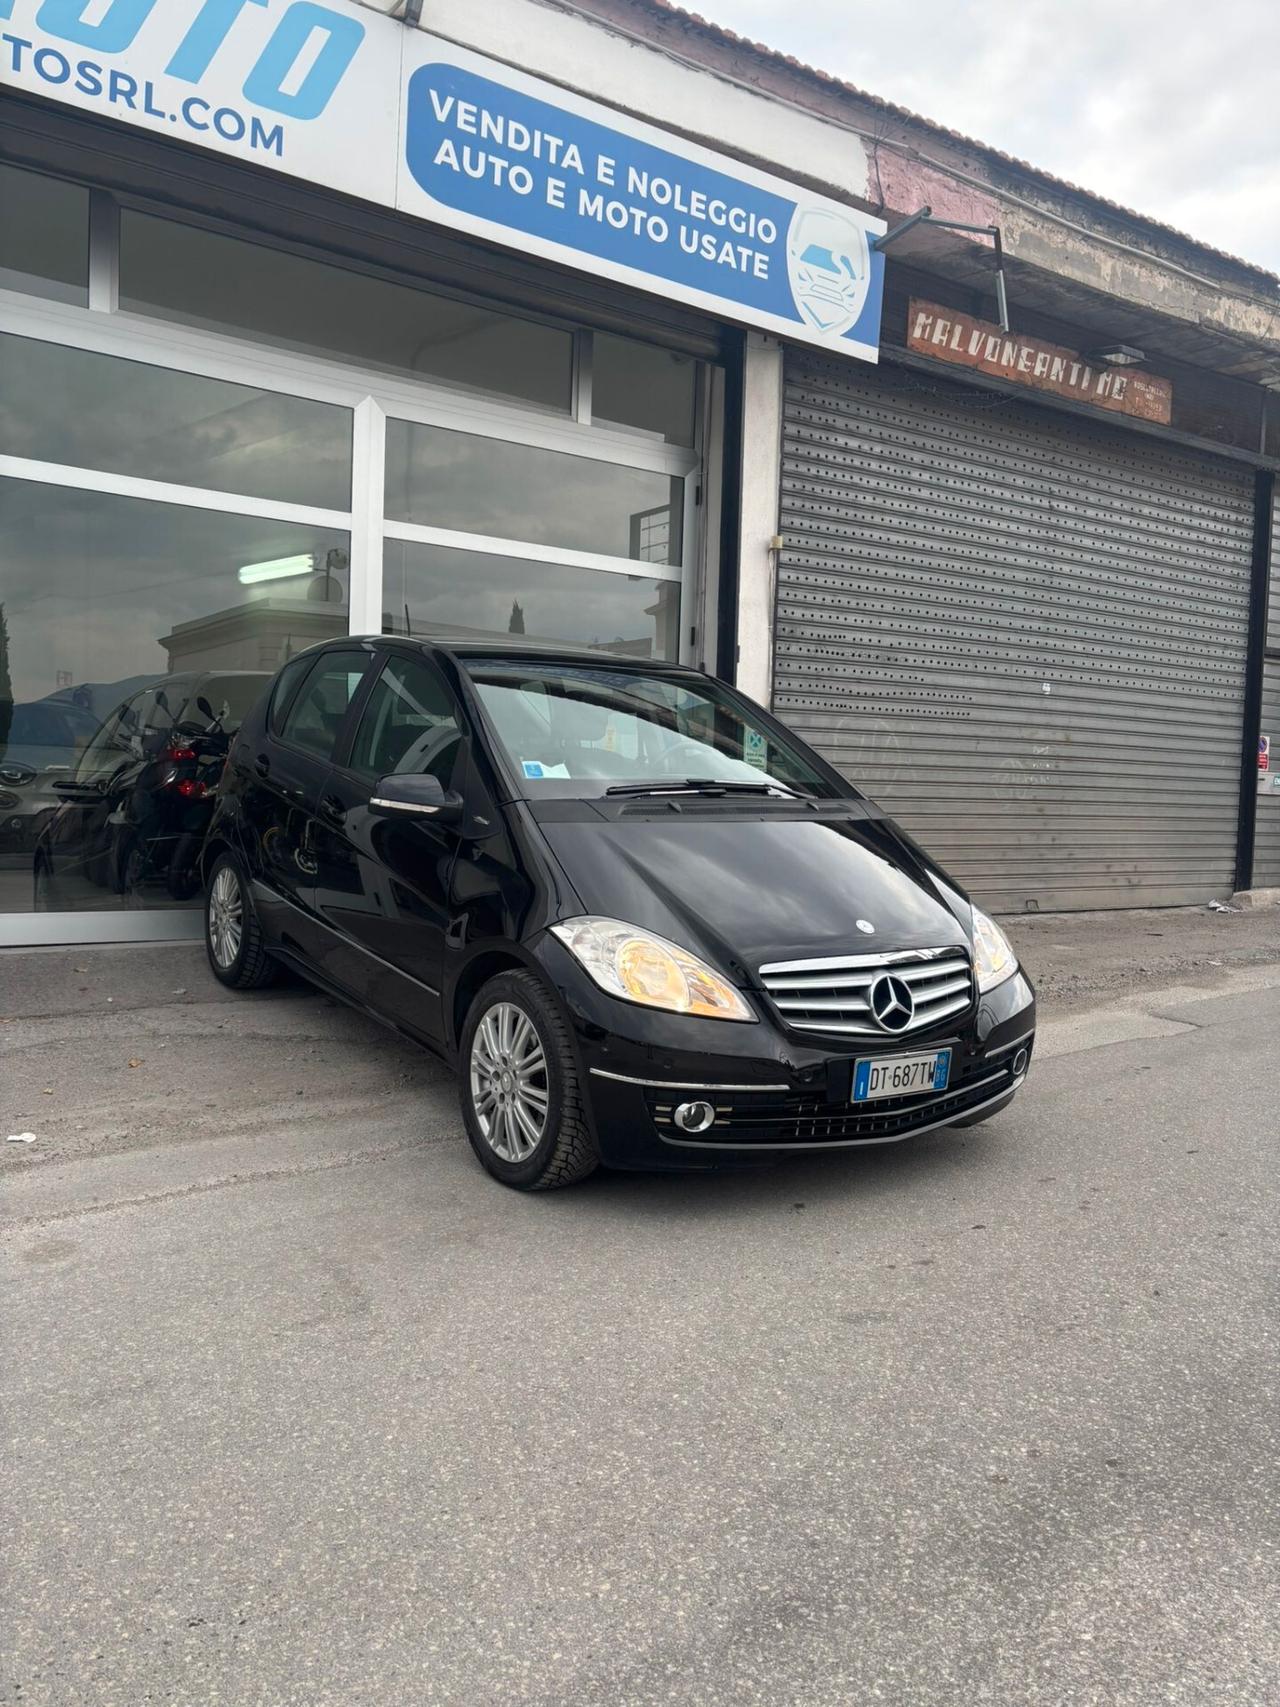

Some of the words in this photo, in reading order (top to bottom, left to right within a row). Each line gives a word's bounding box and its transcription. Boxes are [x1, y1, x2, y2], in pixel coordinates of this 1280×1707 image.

[430, 89, 584, 175] VENDITA
[597, 154, 615, 186] E
[628, 170, 777, 244] NOLEGGIO
[434, 139, 533, 195] AUTO
[546, 177, 566, 209] E
[578, 189, 669, 243] MOTO
[680, 226, 769, 280] USATE
